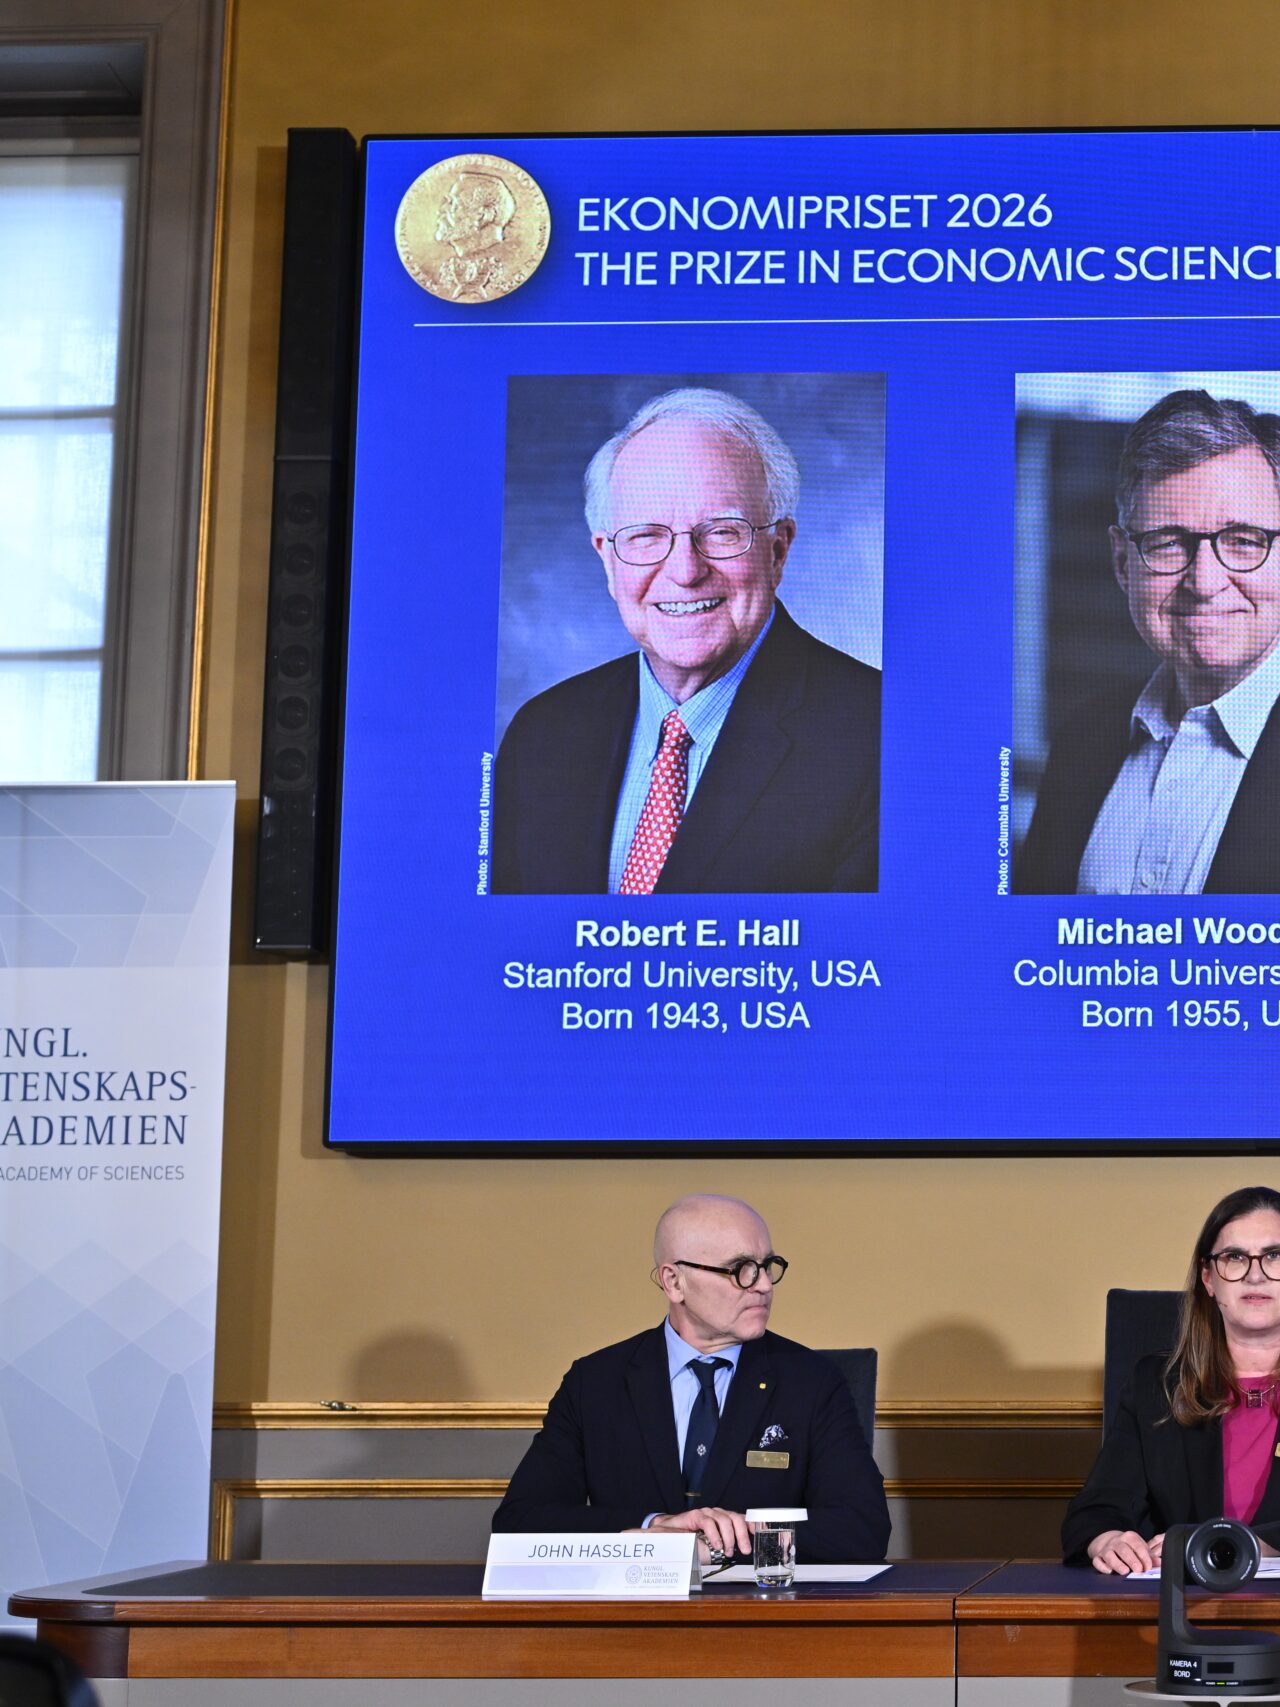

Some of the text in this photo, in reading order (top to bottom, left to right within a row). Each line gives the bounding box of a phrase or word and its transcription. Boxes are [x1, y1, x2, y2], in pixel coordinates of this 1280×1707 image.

[578, 193, 1053, 232] EKONOMIPRISET 2026
[574, 251, 658, 286] THE
[670, 250, 786, 285] PRIZE
[798, 249, 840, 284] IN
[853, 246, 1105, 284] ECONOMIC
[477, 752, 493, 895] Photo: Stanford University
[998, 746, 1011, 895] Photo: Columbia University
[576, 919, 799, 947] Robert E. Hall
[1057, 917, 1182, 945] Michael
[503, 959, 882, 994] Stanford University, USA
[1013, 958, 1159, 986] Columbia
[562, 1001, 811, 1033] Born 1943, USA
[1082, 1000, 1153, 1027] Born
[1166, 999, 1249, 1032] 1955,
[0, 1027, 88, 1058] NGL.
[77, 1165, 99, 1181] OF
[103, 1165, 185, 1181] SCIENCES
[527, 1543, 655, 1558] JOHN HASSLER
[1169, 1659, 1198, 1669] KAMERA 4
